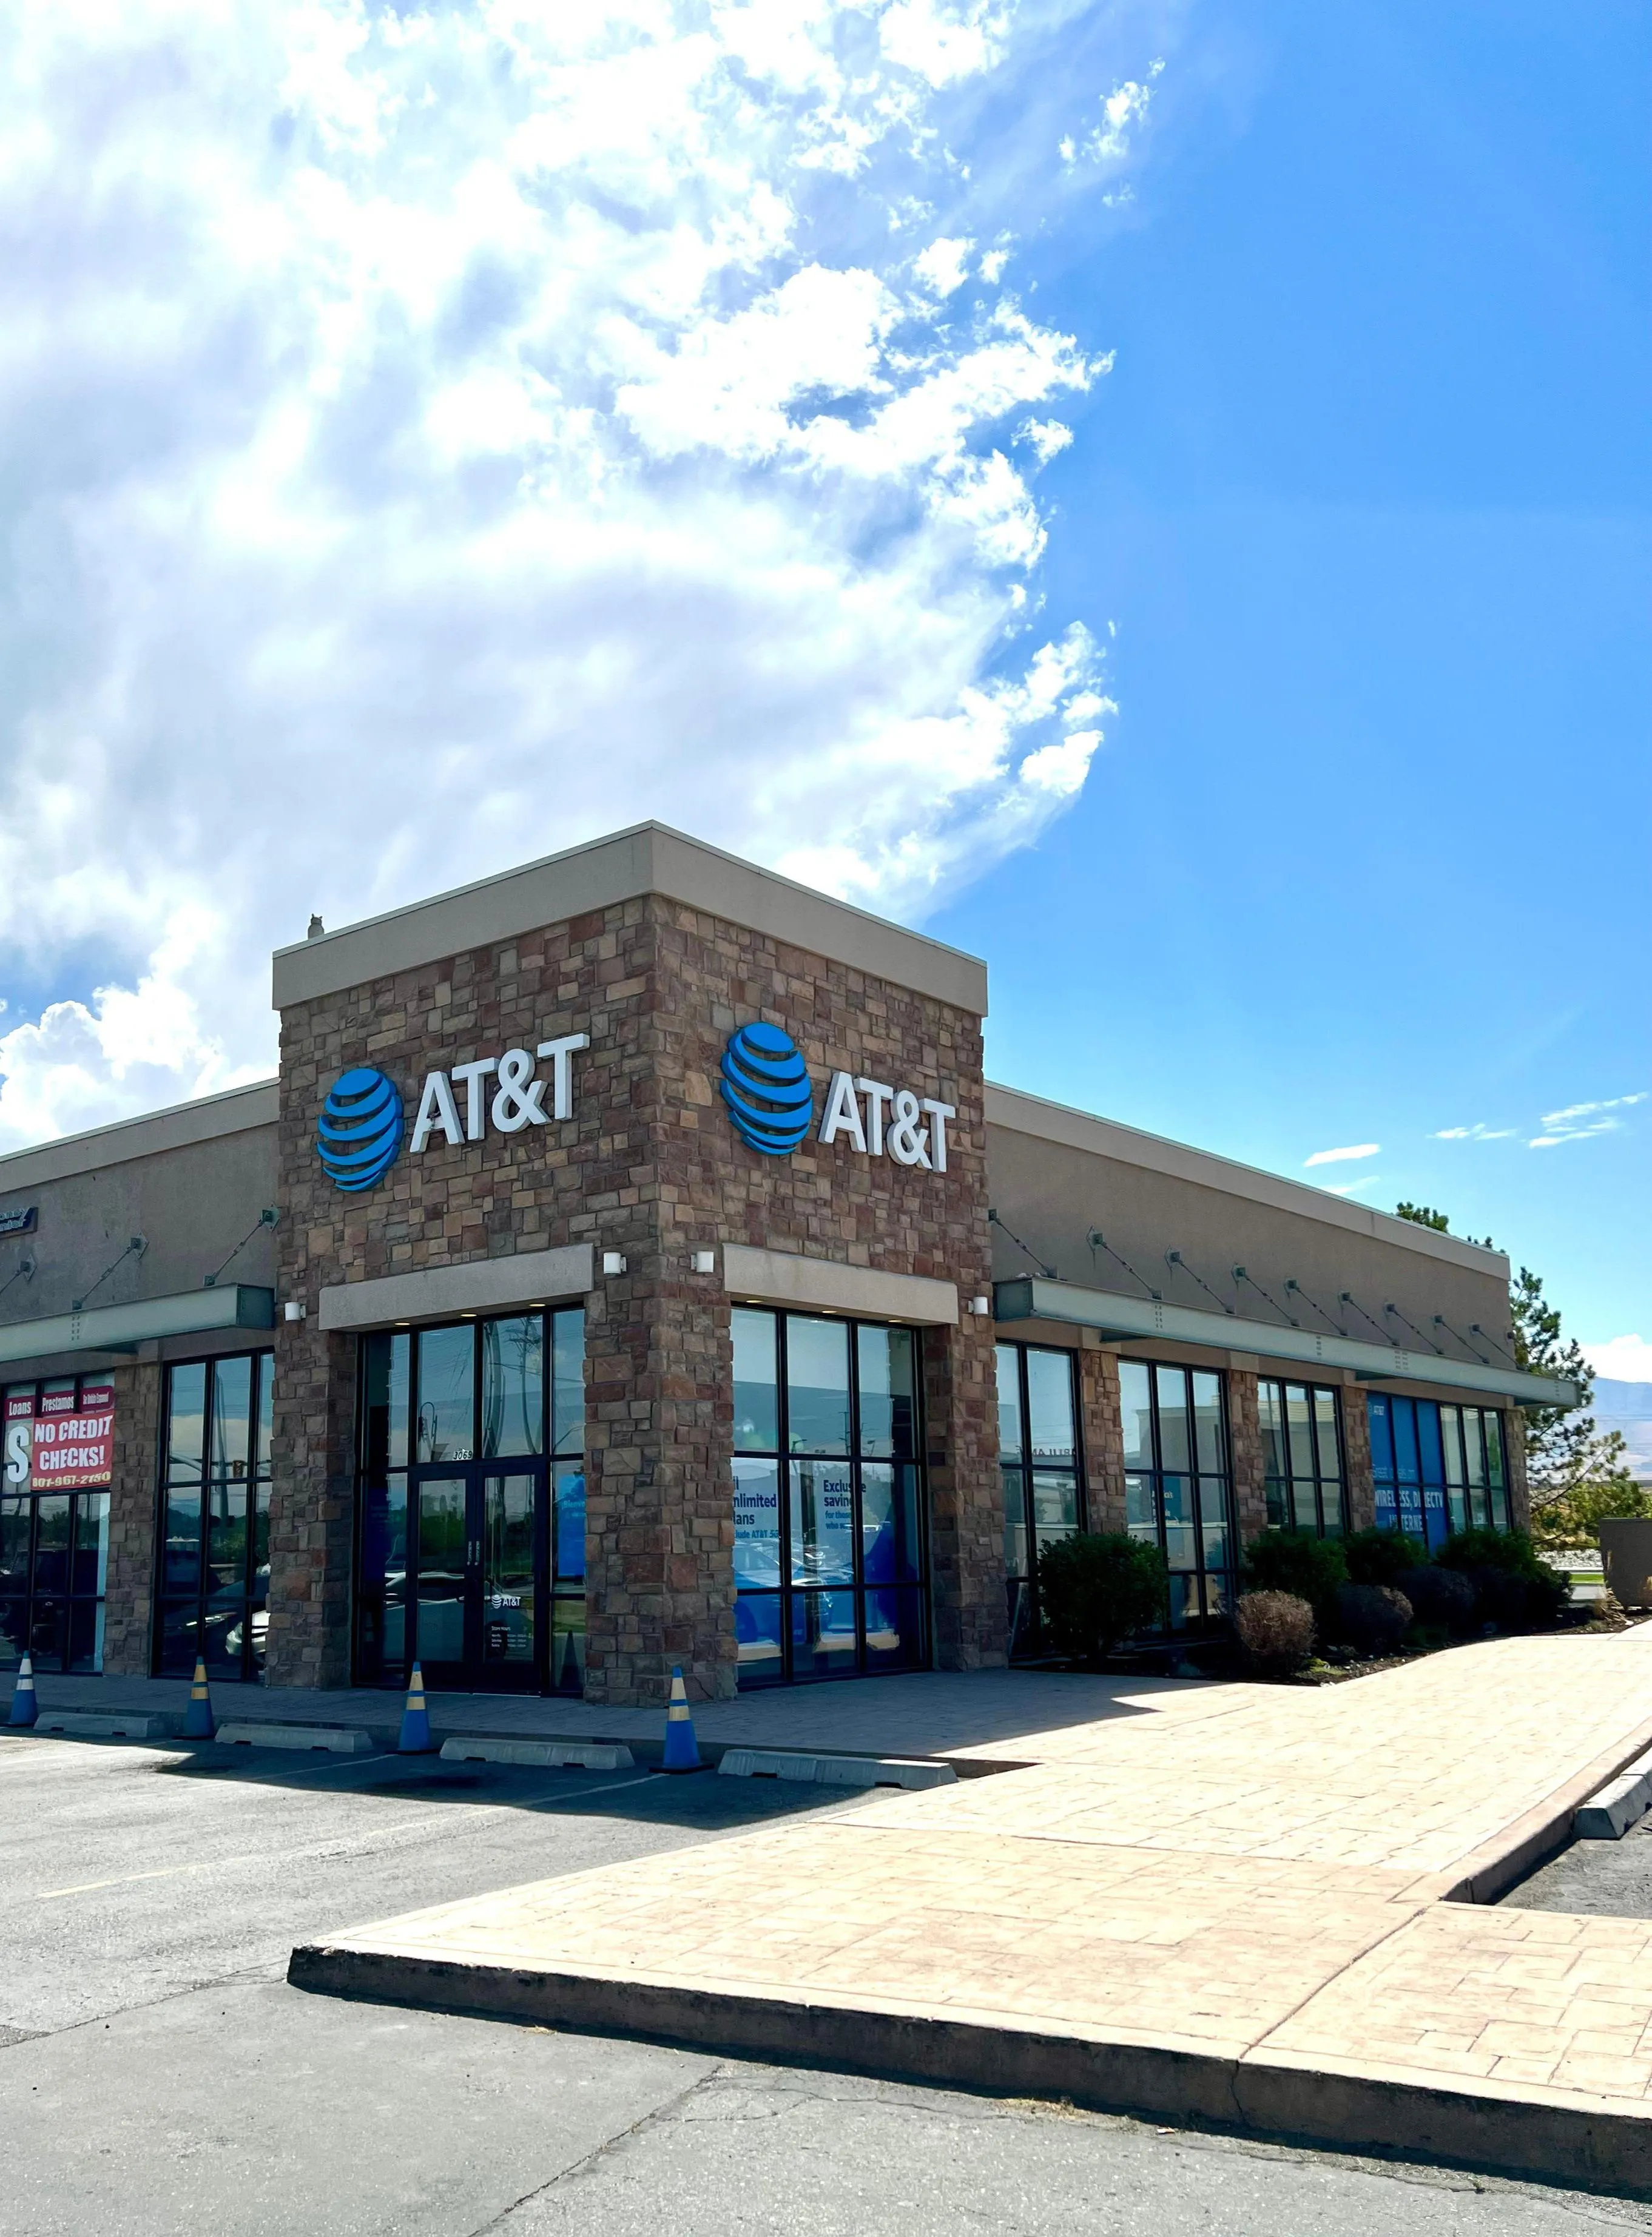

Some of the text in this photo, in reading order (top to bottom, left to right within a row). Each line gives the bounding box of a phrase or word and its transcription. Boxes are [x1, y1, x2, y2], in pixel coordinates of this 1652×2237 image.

[410, 1033, 590, 1153] AT&T
[818, 1071, 956, 1173] AT&T
[8, 1401, 32, 1416] Loans
[34, 1415, 113, 1443] NO CREDIT
[39, 1445, 105, 1471] CHECKS!
[453, 1450, 472, 1460] 3069
[502, 1596, 521, 1607] AT&T
